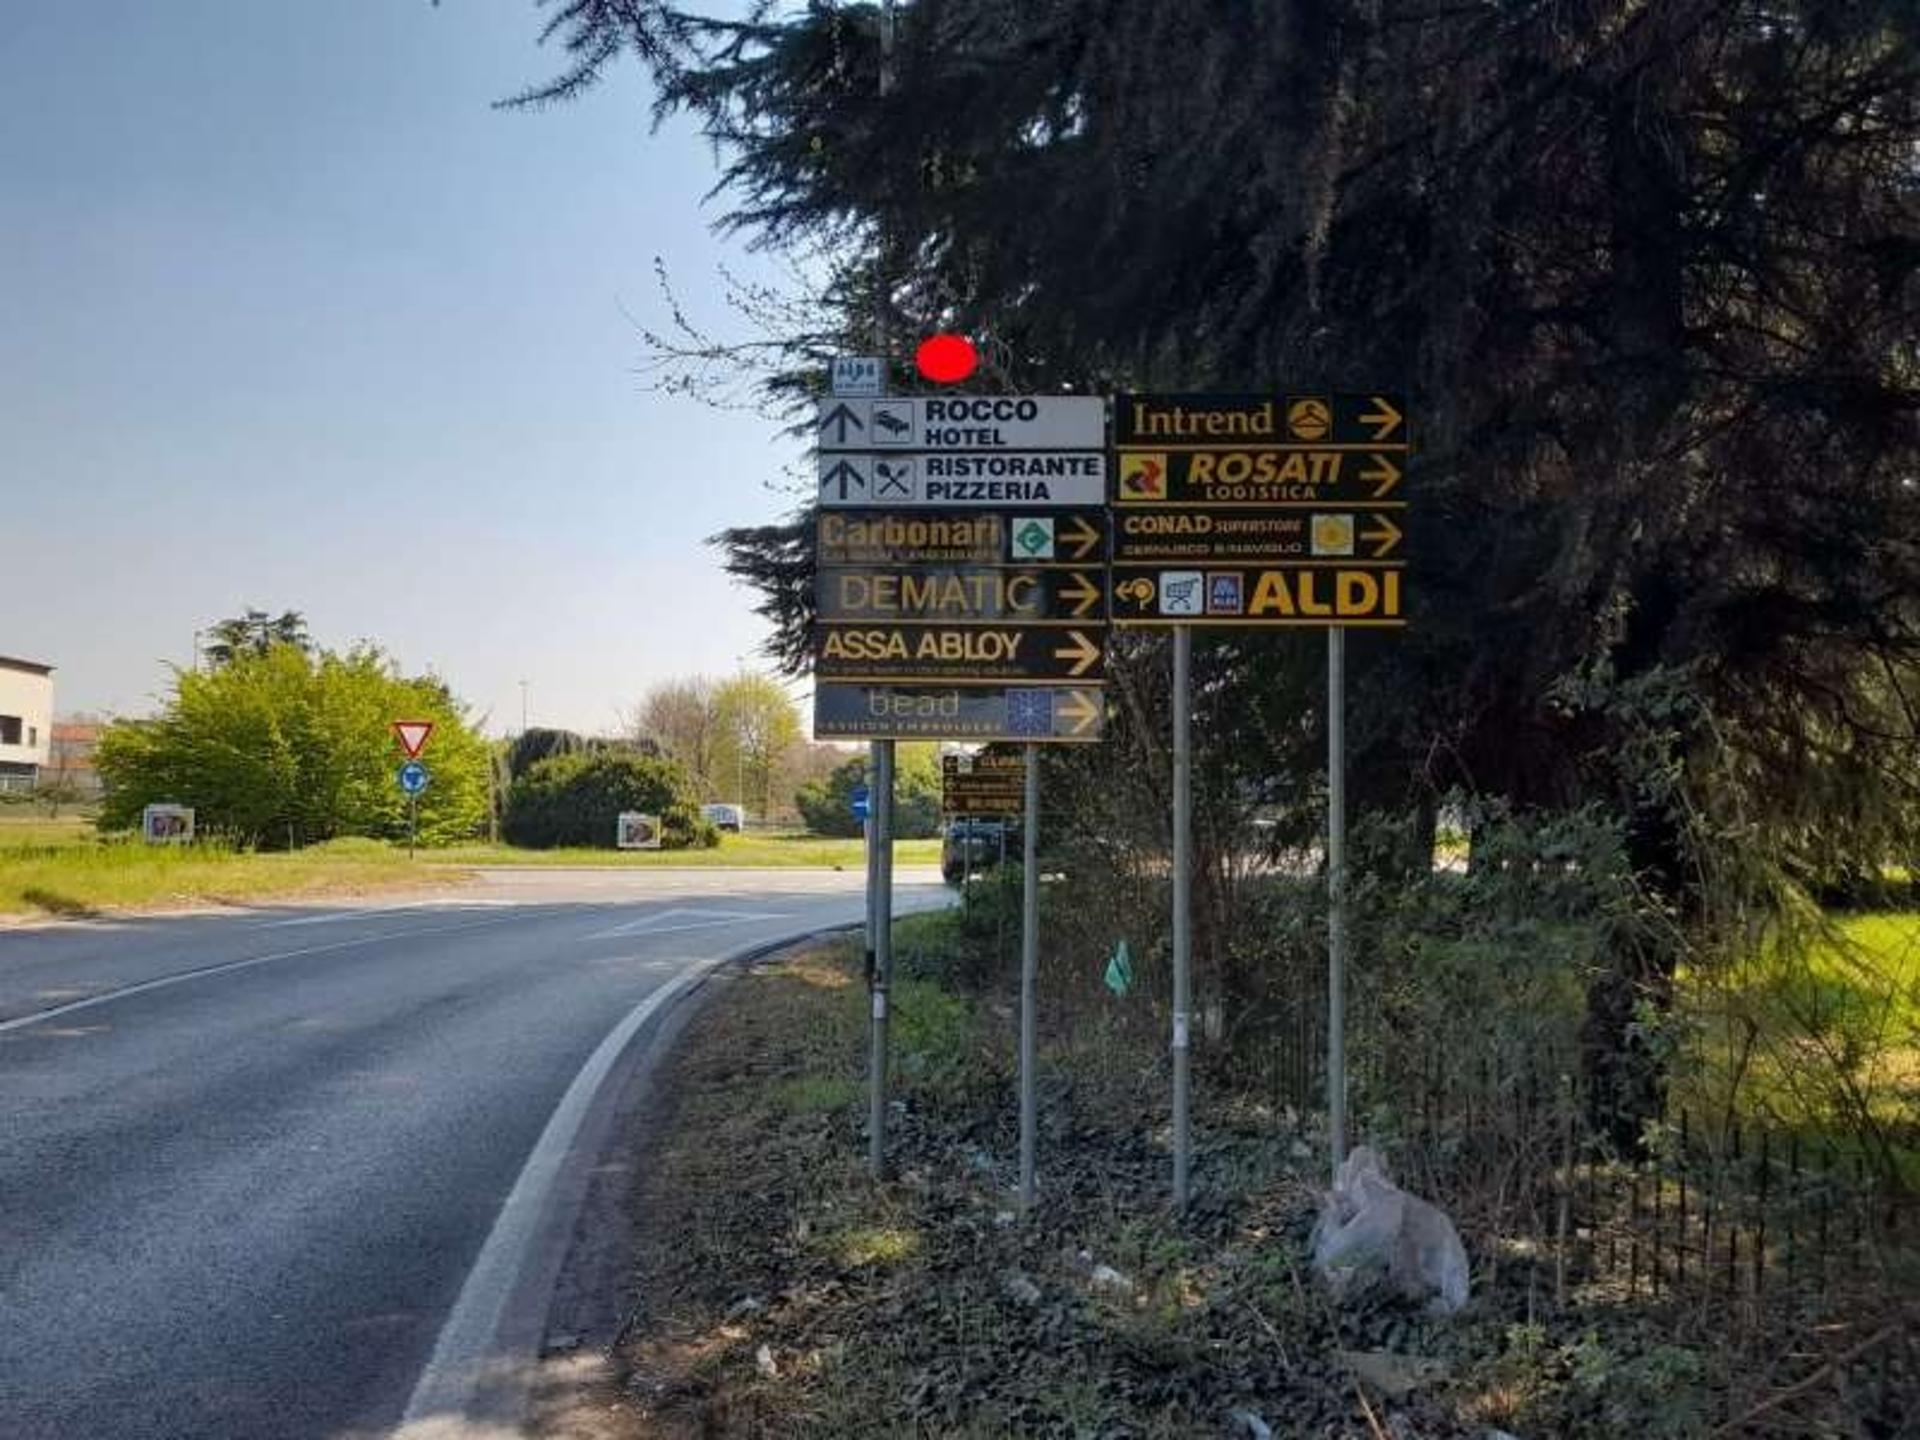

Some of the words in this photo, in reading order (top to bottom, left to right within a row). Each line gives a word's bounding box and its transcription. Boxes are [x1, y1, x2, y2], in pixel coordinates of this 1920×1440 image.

[925, 400, 1037, 422] ROCCO
[1133, 403, 1273, 435] Intrend
[926, 429, 1006, 445] HOTEL
[926, 458, 1099, 476] RISTORANTE
[1188, 454, 1343, 483] ROSATI
[926, 482, 1050, 500] PIZZERIA
[1206, 486, 1316, 499] LOGISTICA
[822, 514, 998, 546] Carbonari
[1124, 515, 1212, 534] CONAD
[840, 576, 1037, 611] DEMATIC
[1248, 571, 1399, 615] ALDI
[822, 631, 907, 660] ASSA
[916, 632, 1021, 660] ABLOY
[869, 689, 959, 716] bead
